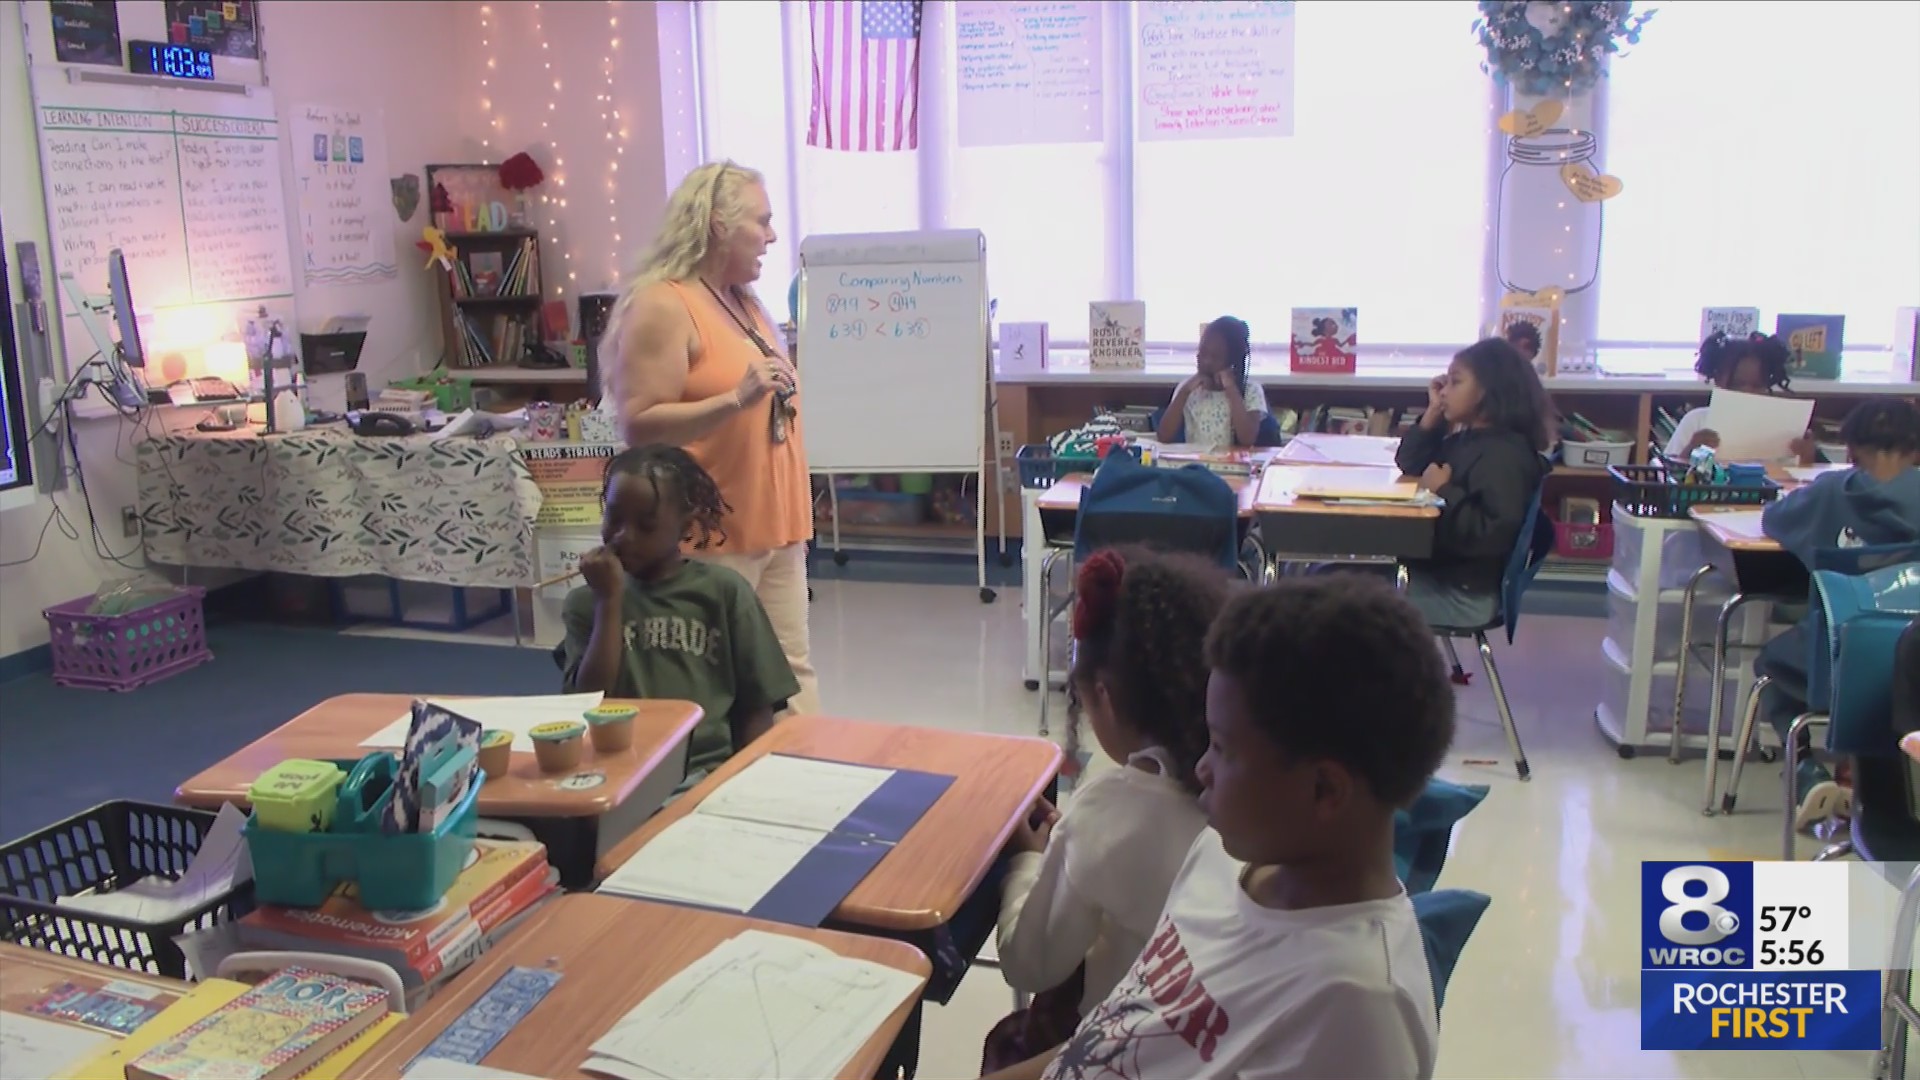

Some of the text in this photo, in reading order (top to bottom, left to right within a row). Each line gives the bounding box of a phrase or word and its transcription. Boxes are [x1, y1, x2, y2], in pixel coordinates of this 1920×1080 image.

[43, 110, 152, 127] LEARNING INTENTION
[182, 116, 230, 133] SUCCESS
[839, 270, 963, 293] Comparing Numbers
[1093, 328, 1120, 337] ROSIE
[1093, 337, 1130, 347] REVERE
[1093, 347, 1142, 357] ENGINEER
[531, 445, 613, 460] READS STRATEGY
